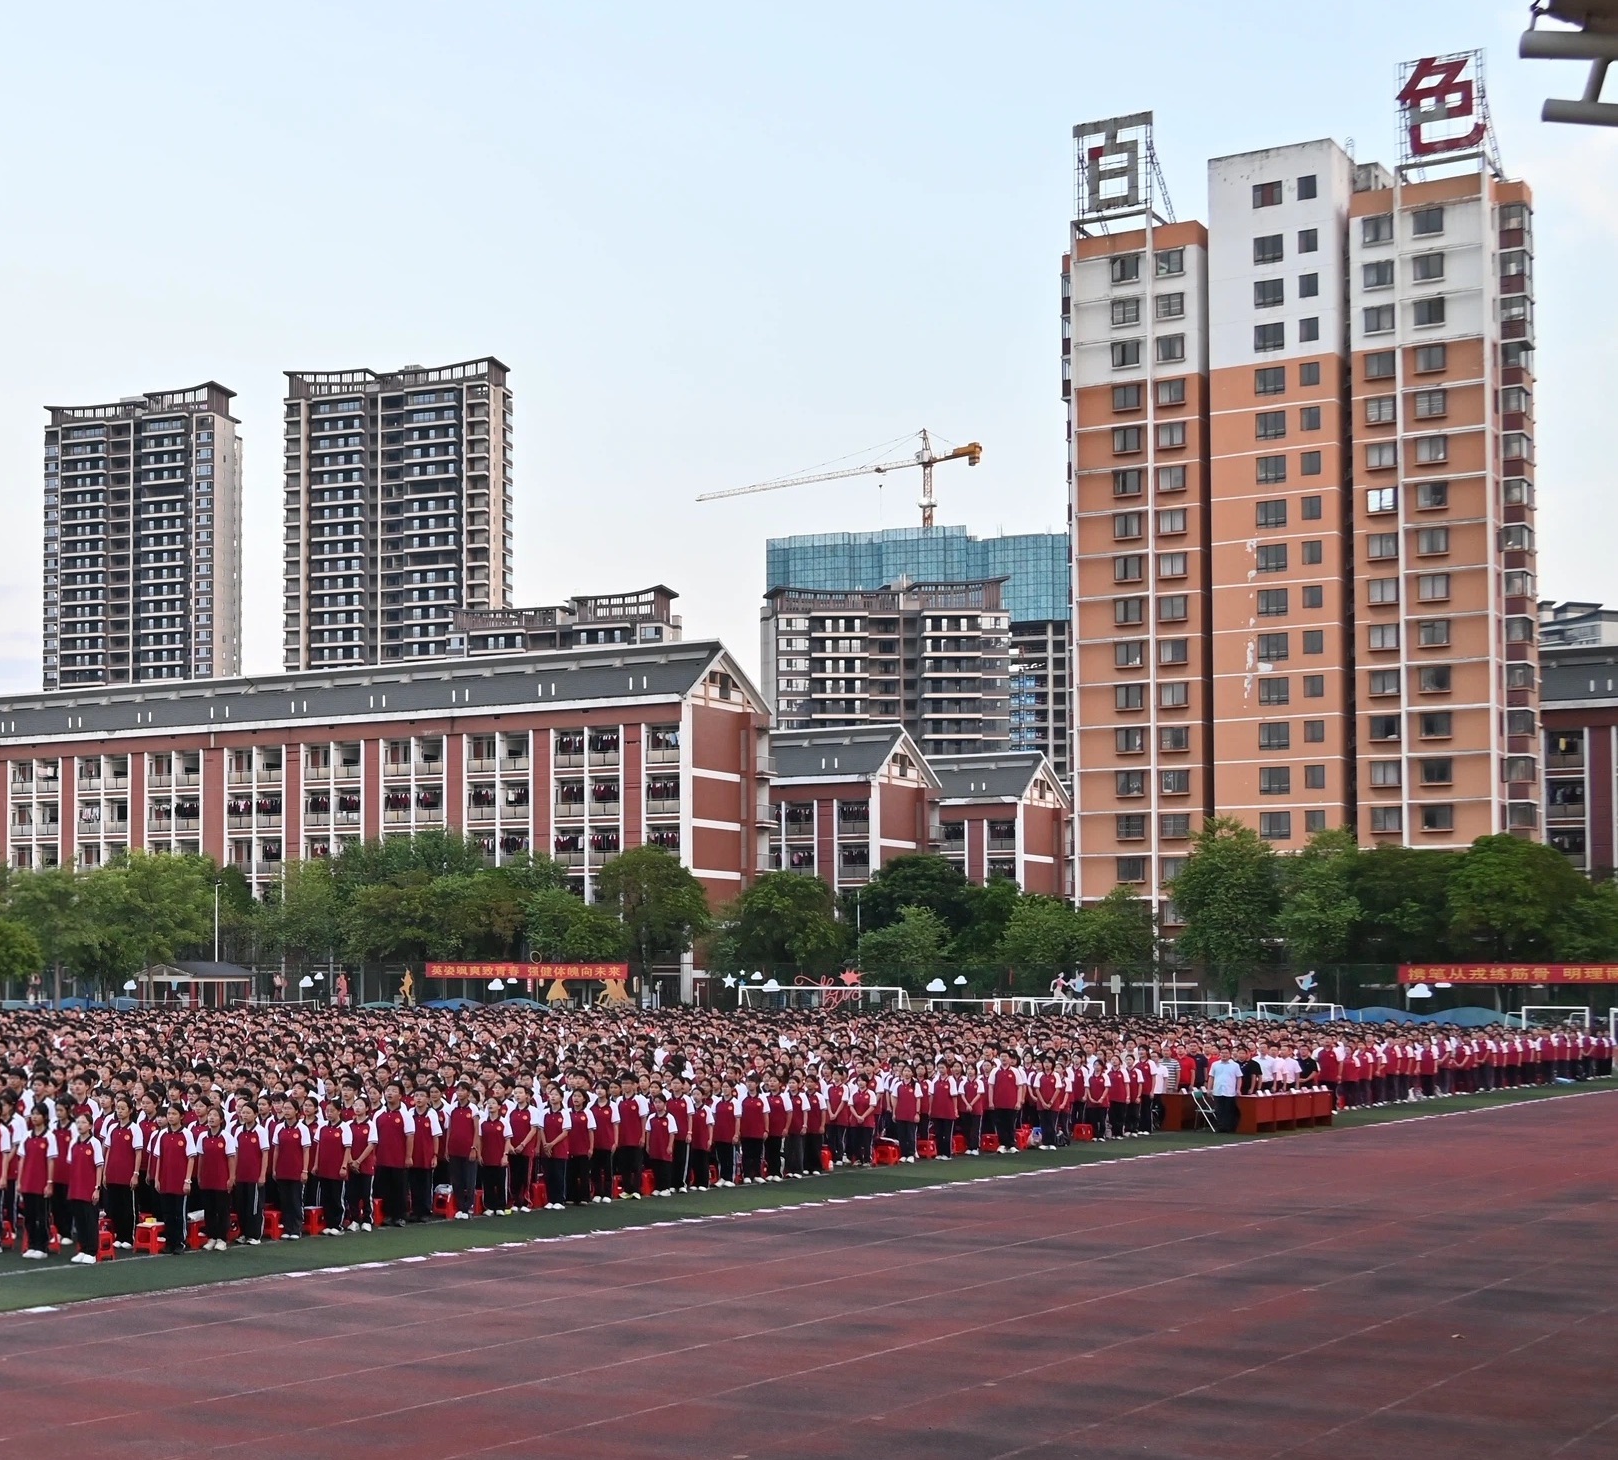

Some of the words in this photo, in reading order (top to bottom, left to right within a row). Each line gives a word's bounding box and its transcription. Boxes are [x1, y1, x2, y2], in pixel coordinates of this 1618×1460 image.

[1395, 57, 1486, 156] 色
[1073, 111, 1153, 209] 百
[431, 965, 520, 977] 英姿飒爽致青春
[527, 966, 621, 977] 强健体魄向未来
